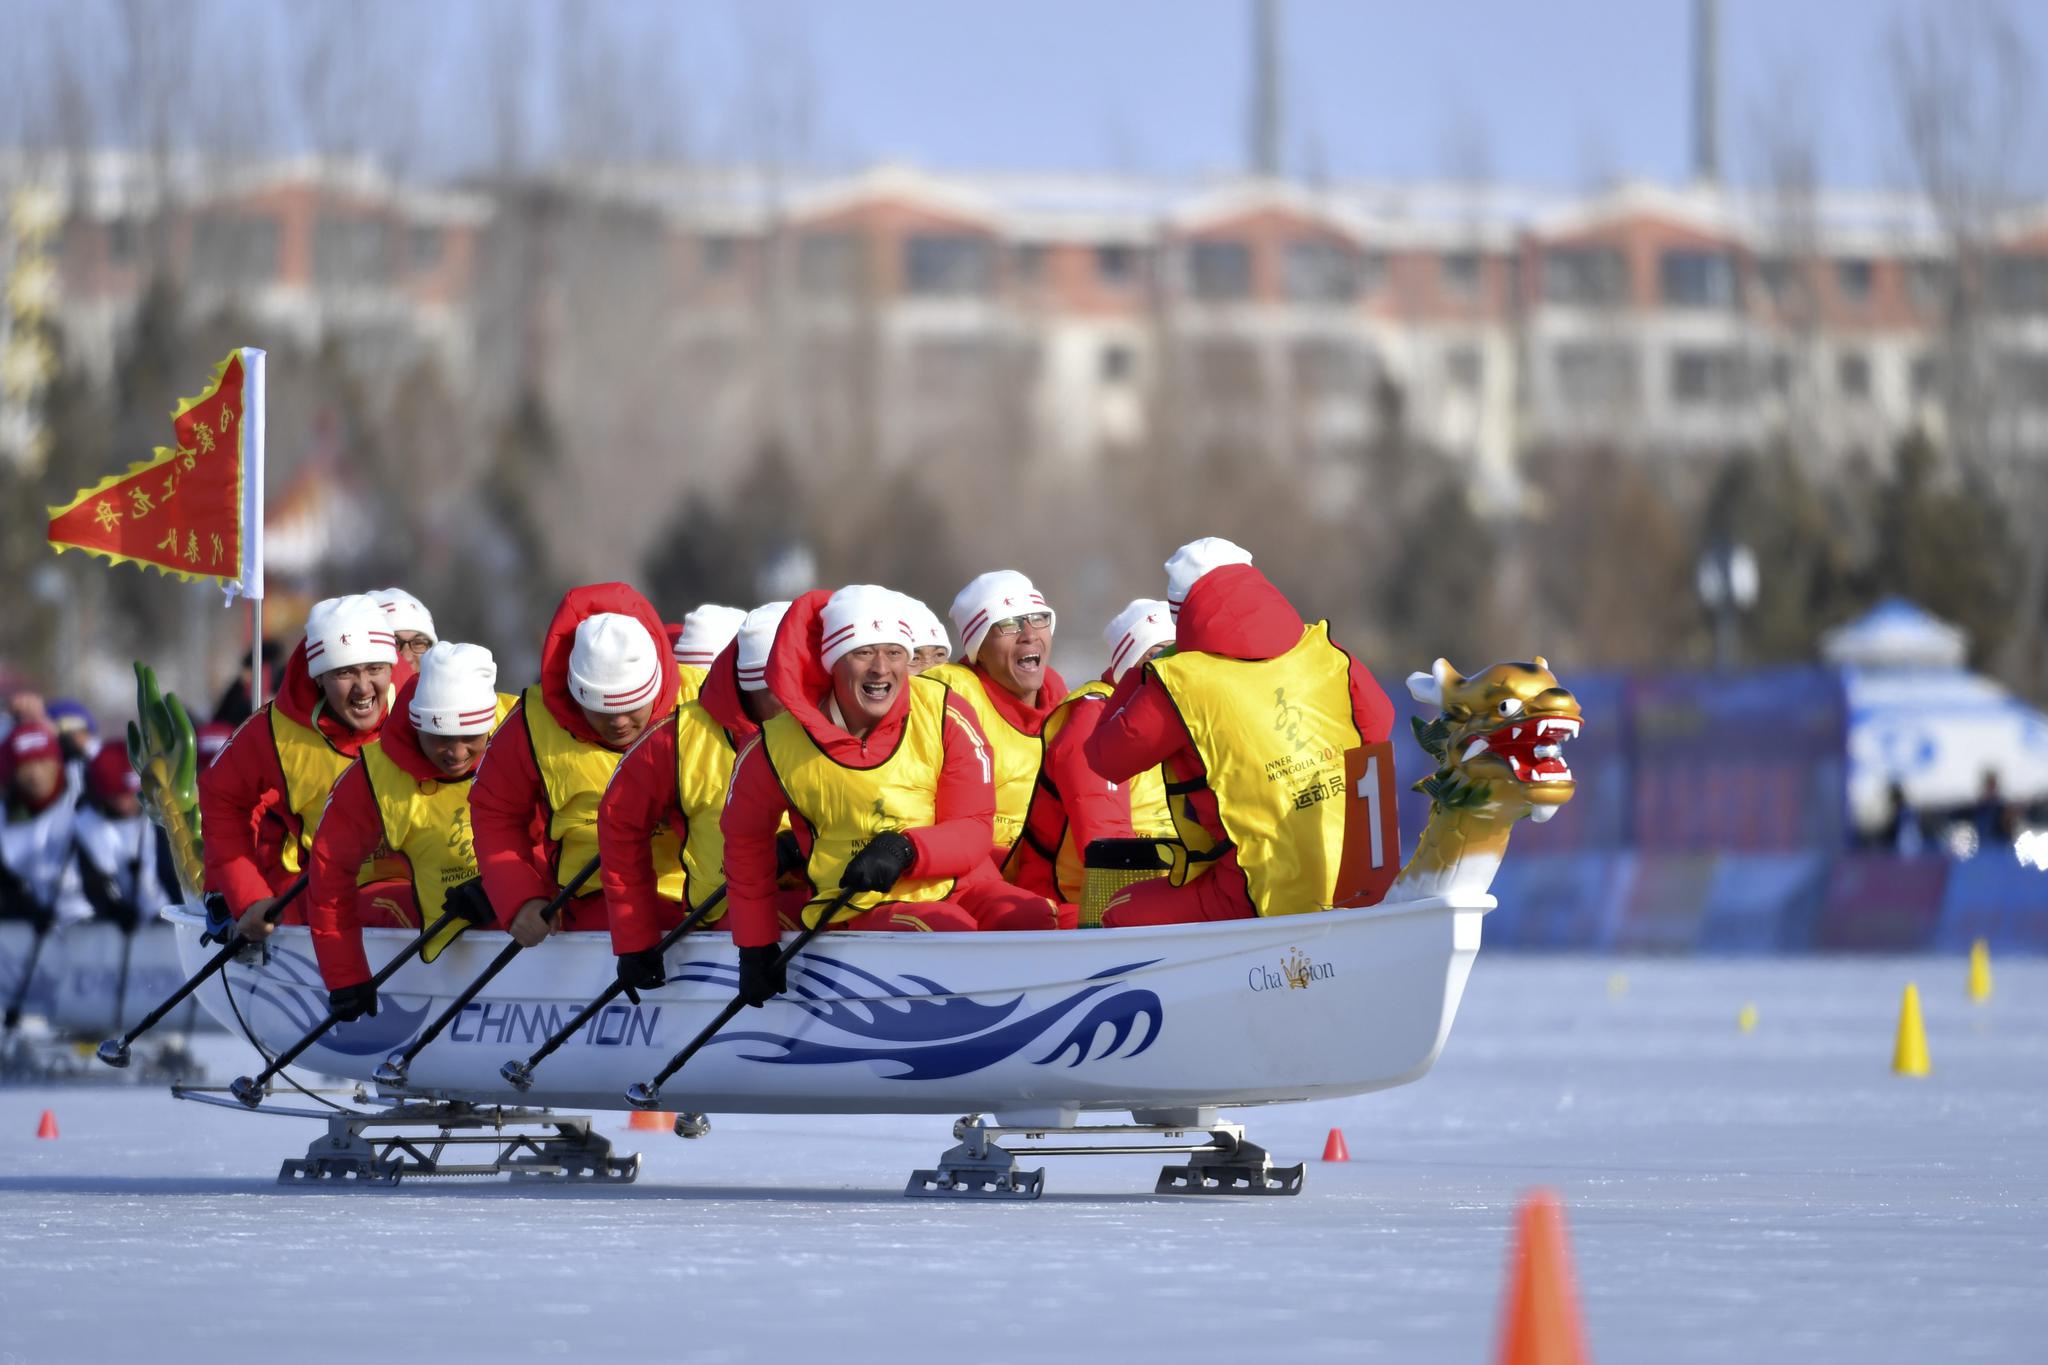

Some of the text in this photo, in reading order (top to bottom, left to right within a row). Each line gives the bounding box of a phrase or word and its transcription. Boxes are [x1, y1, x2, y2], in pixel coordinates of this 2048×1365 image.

[1265, 755, 1293, 772] INNER
[1267, 758, 1316, 783] MONGOLIA
[1317, 743, 1345, 762] 2020
[1292, 775, 1346, 811] 运动员
[1356, 755, 1384, 870] 1
[441, 867, 481, 883] MONGOLI
[1248, 956, 1336, 992] Chapion
